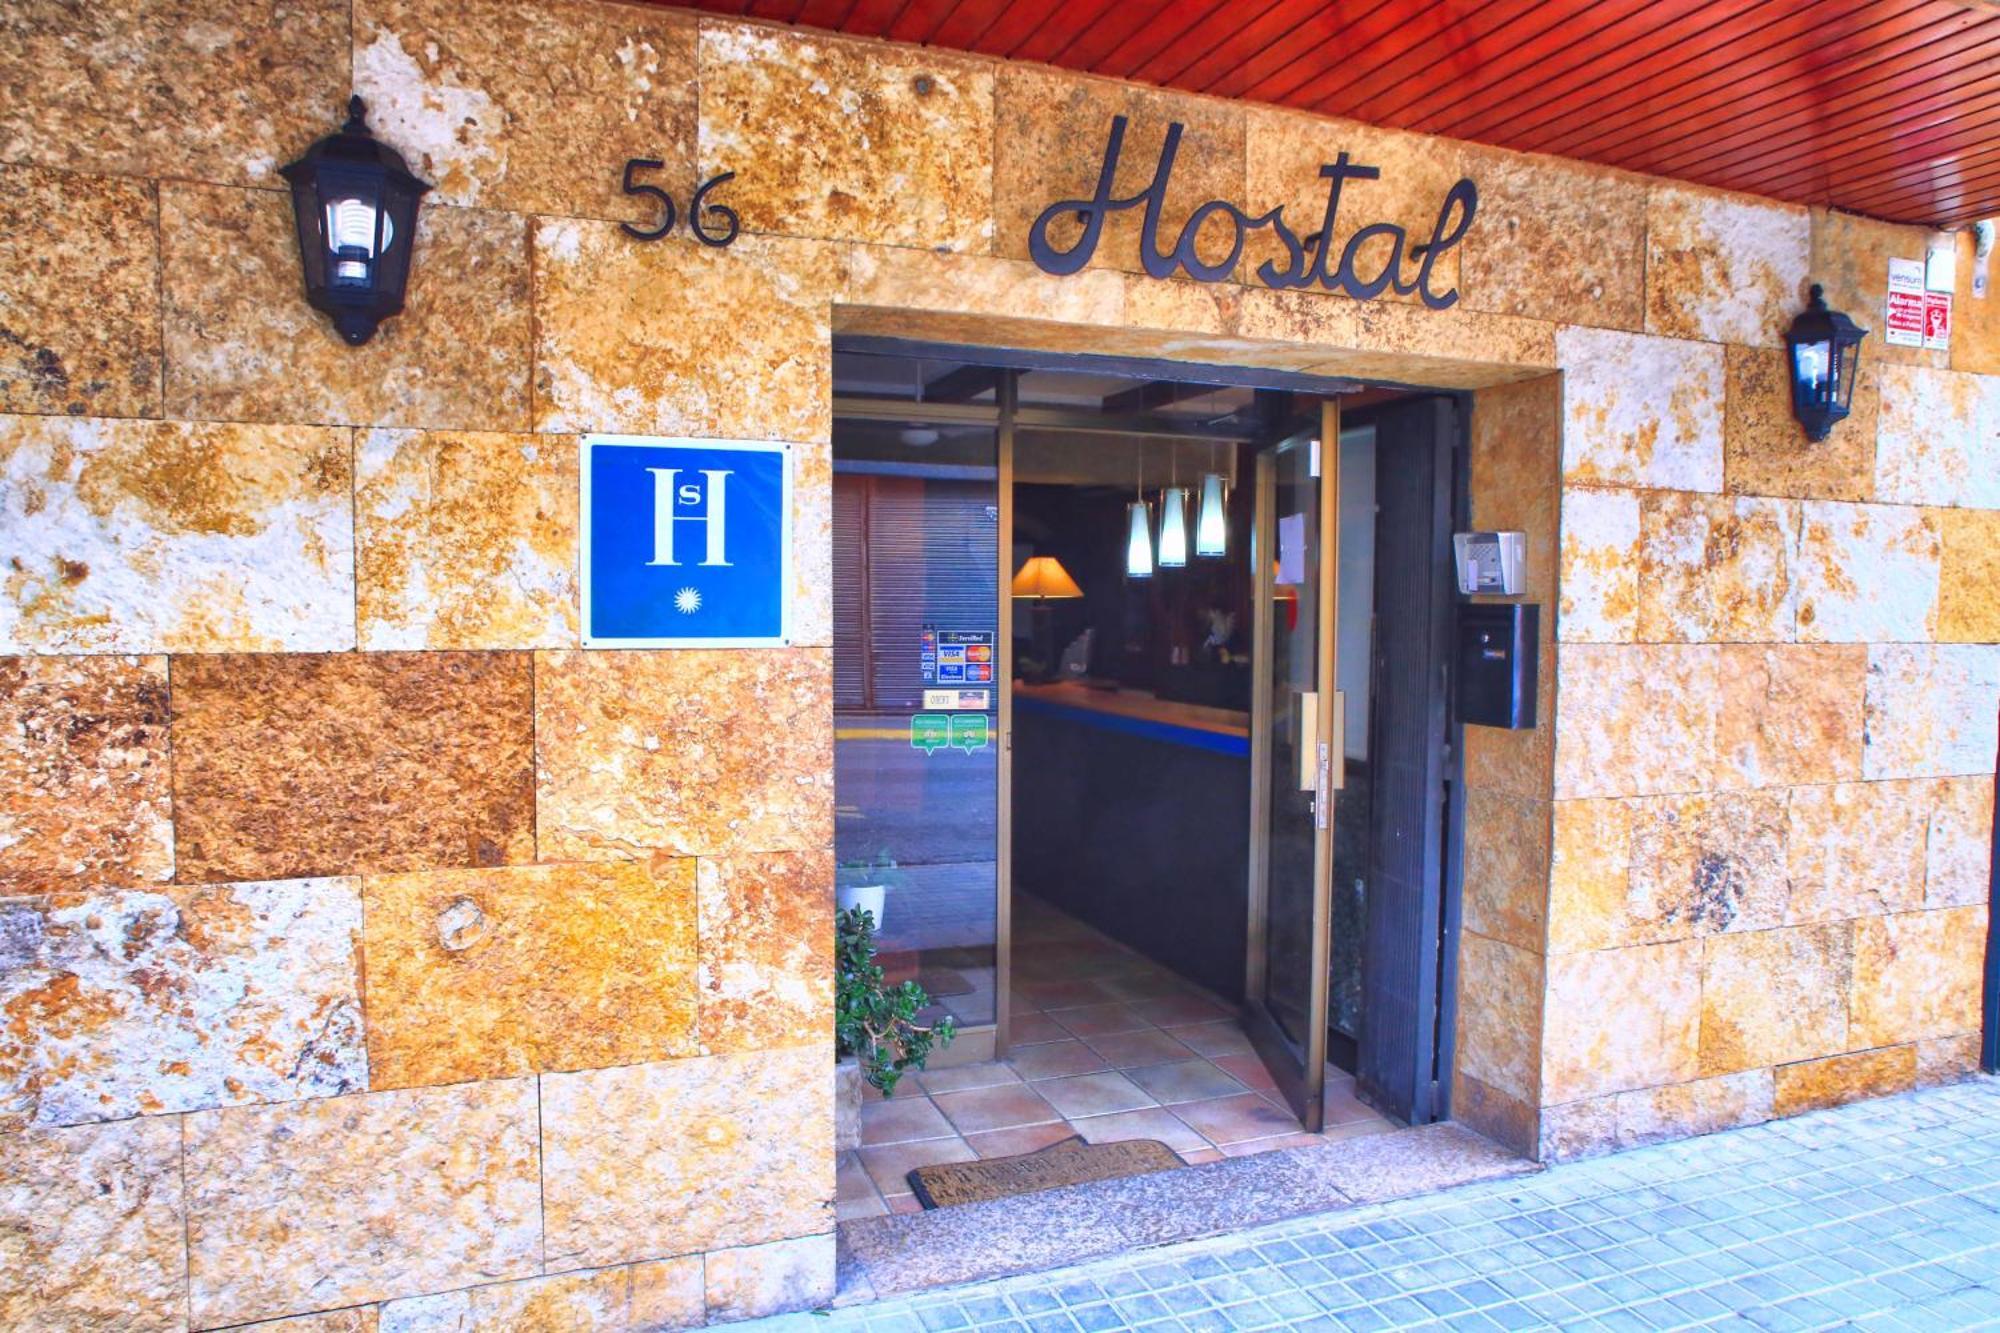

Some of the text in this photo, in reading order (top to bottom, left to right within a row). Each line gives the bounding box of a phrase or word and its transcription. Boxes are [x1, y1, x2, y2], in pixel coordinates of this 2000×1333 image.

[620, 159, 739, 247] 56
[1028, 115, 1478, 311] Hostal
[644, 467, 735, 566] H
